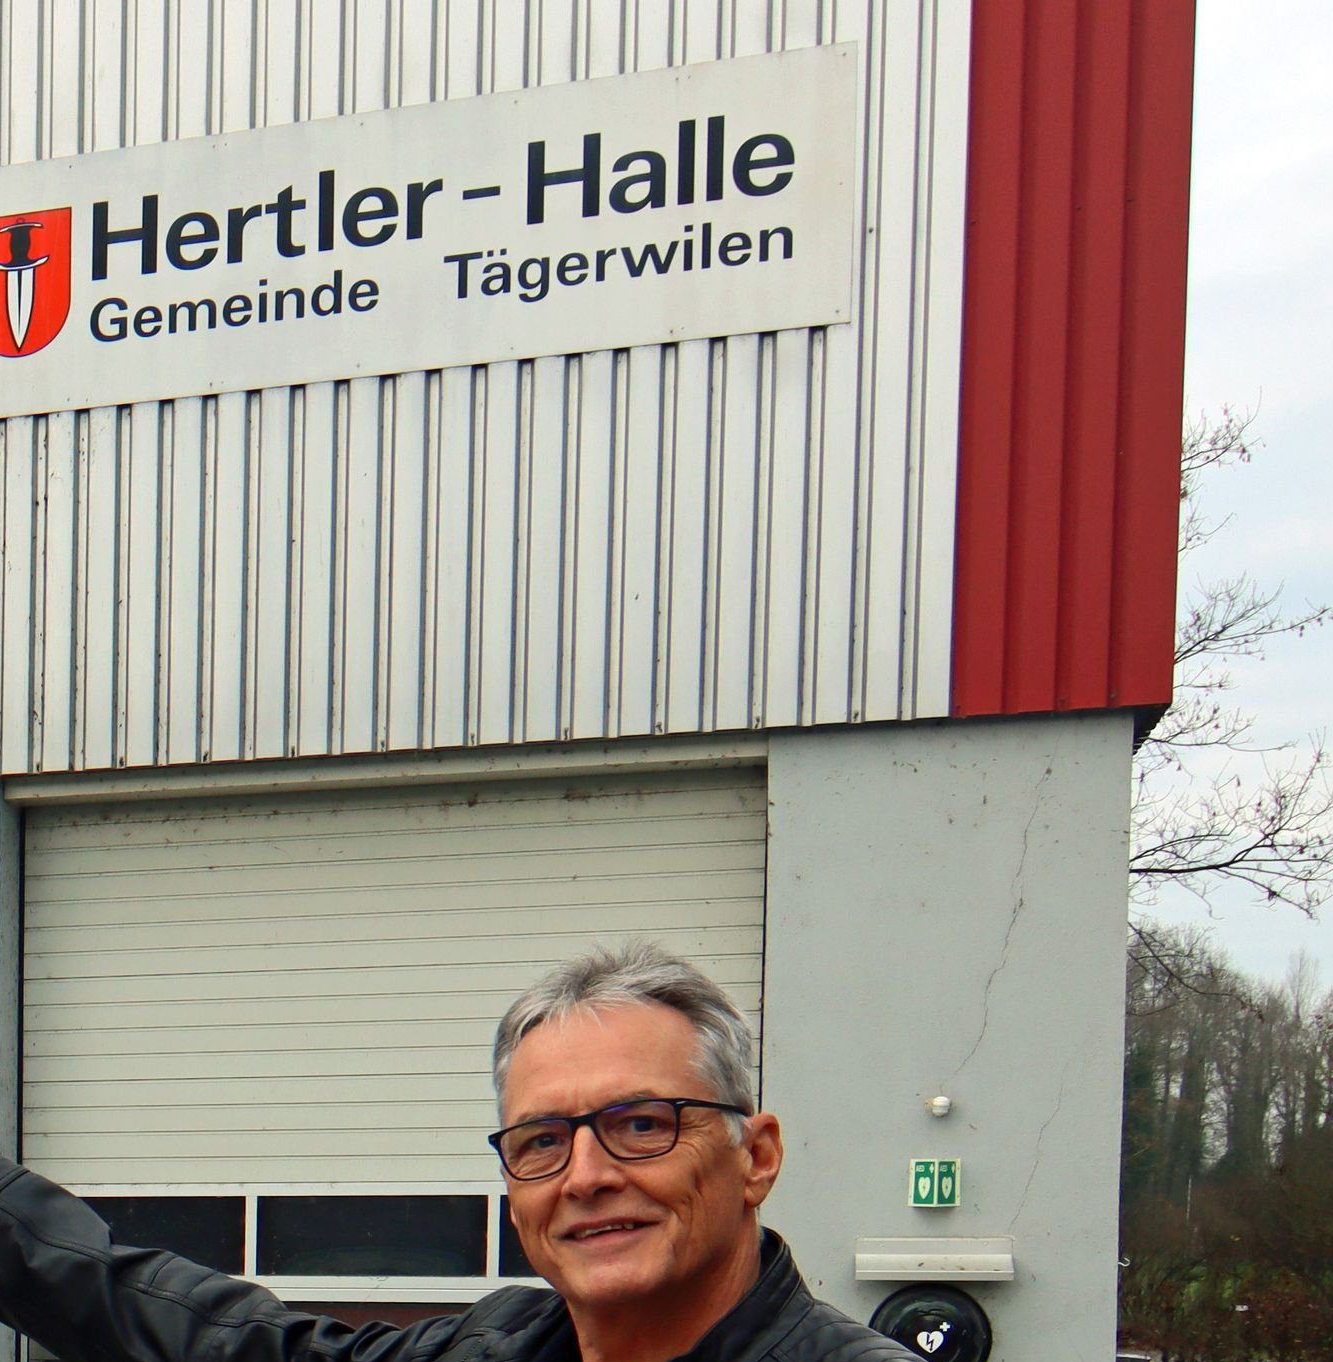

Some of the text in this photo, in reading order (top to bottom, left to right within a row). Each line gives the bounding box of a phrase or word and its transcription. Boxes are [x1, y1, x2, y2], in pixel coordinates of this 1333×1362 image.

[91, 169, 444, 281] Hertler
[525, 115, 795, 225] Halle
[89, 222, 793, 342] Gemeinde Tägerwilen
